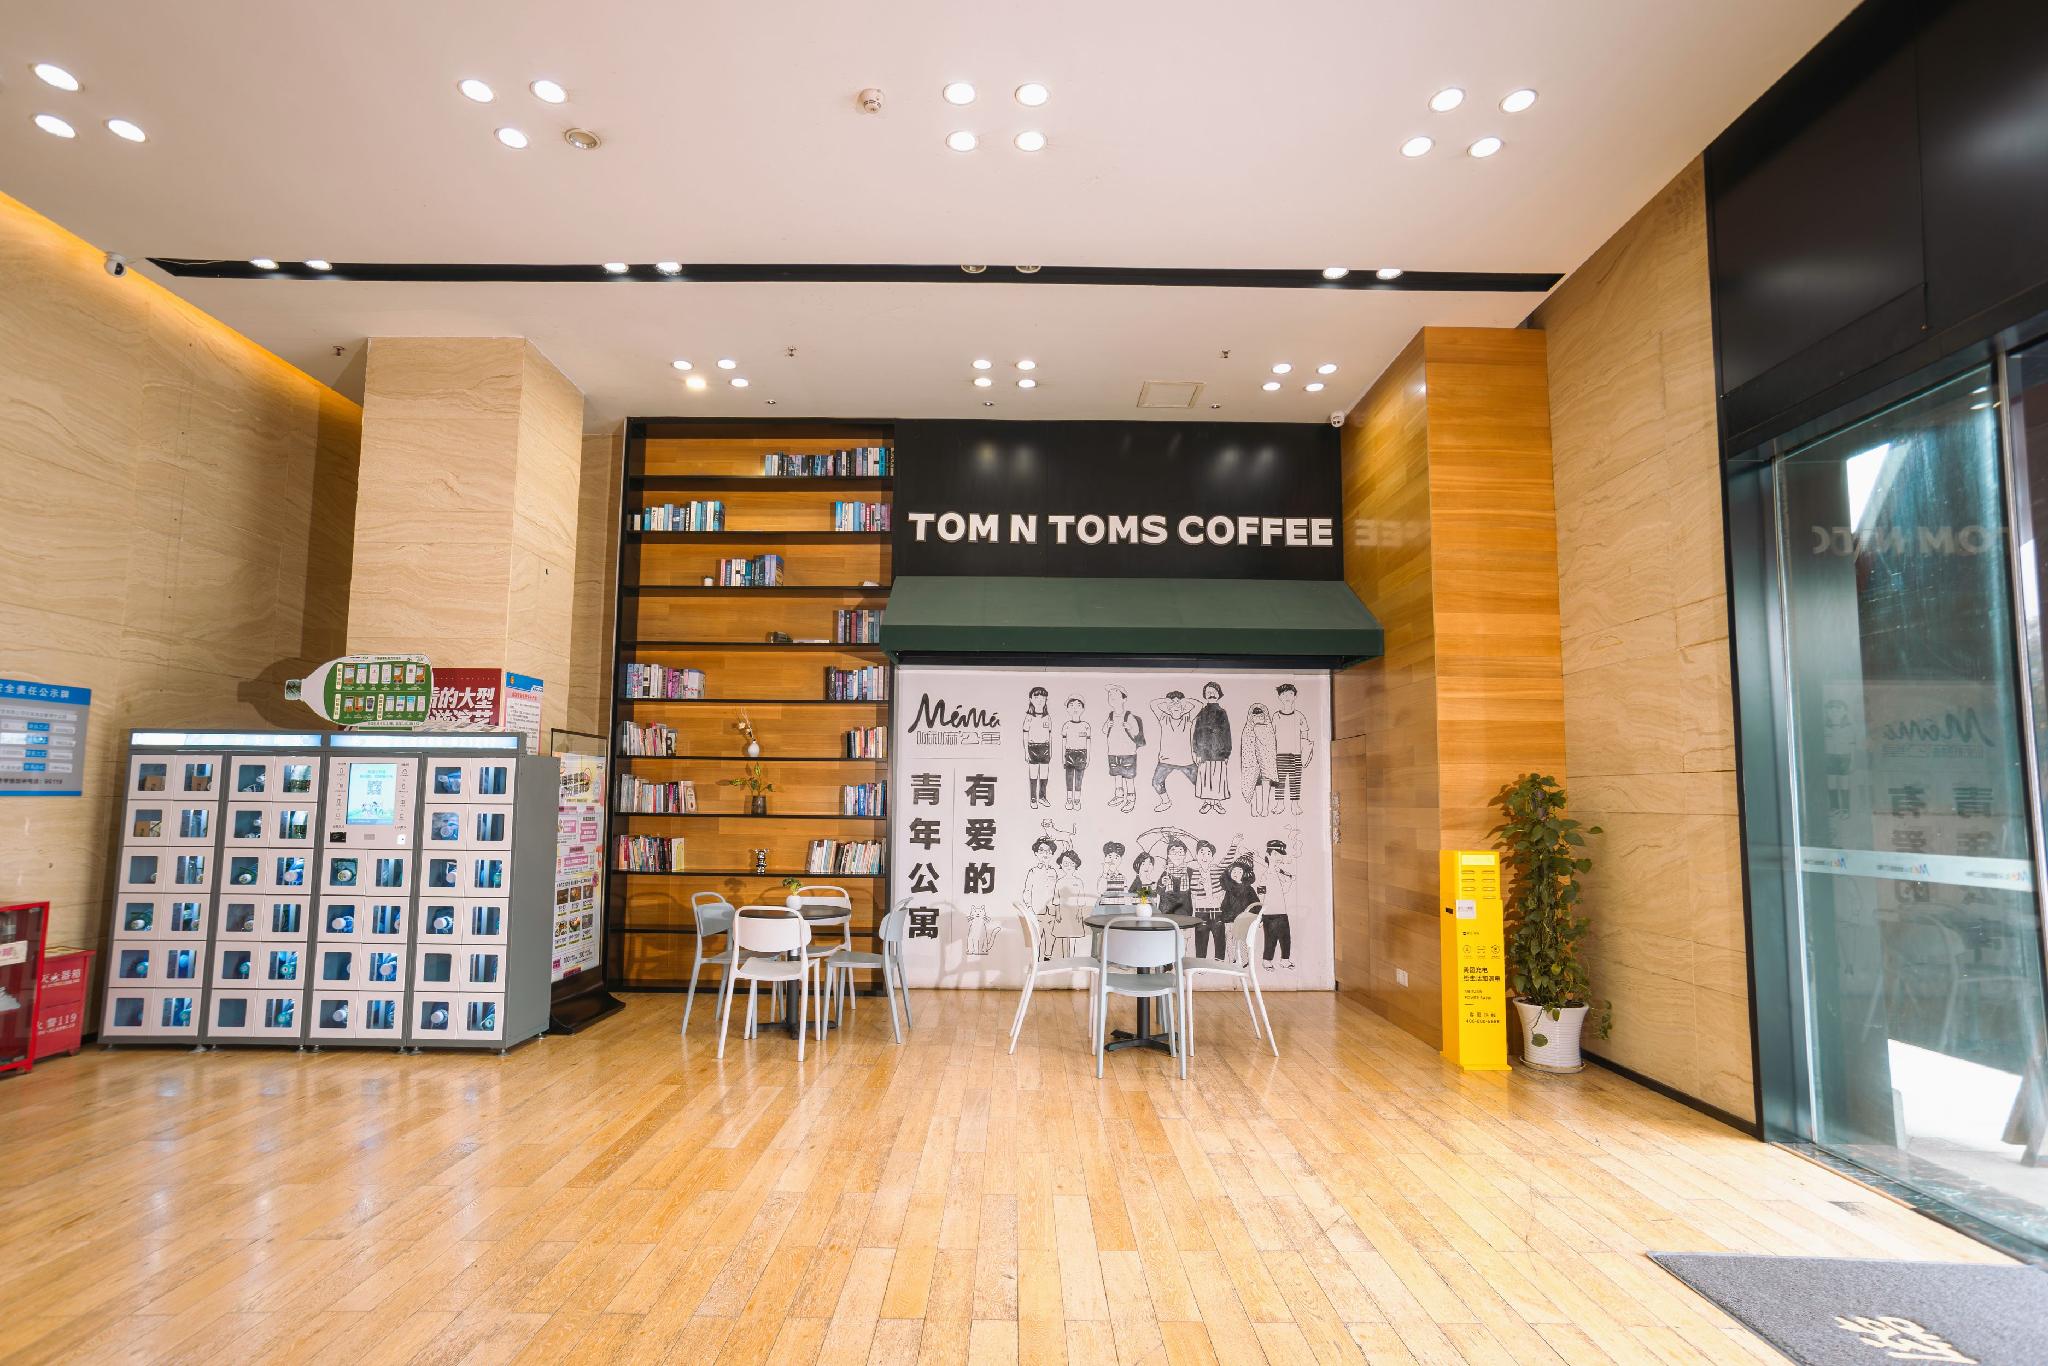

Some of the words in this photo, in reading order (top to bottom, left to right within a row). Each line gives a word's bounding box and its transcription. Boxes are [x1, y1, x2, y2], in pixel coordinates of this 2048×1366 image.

[908, 512, 999, 543] TOM
[1010, 514, 1038, 544] N
[1048, 514, 1168, 544] TOMS
[1178, 515, 1333, 546] COFFEE
[907, 772, 942, 940] 青年公寓
[963, 773, 998, 895] 有爱的
